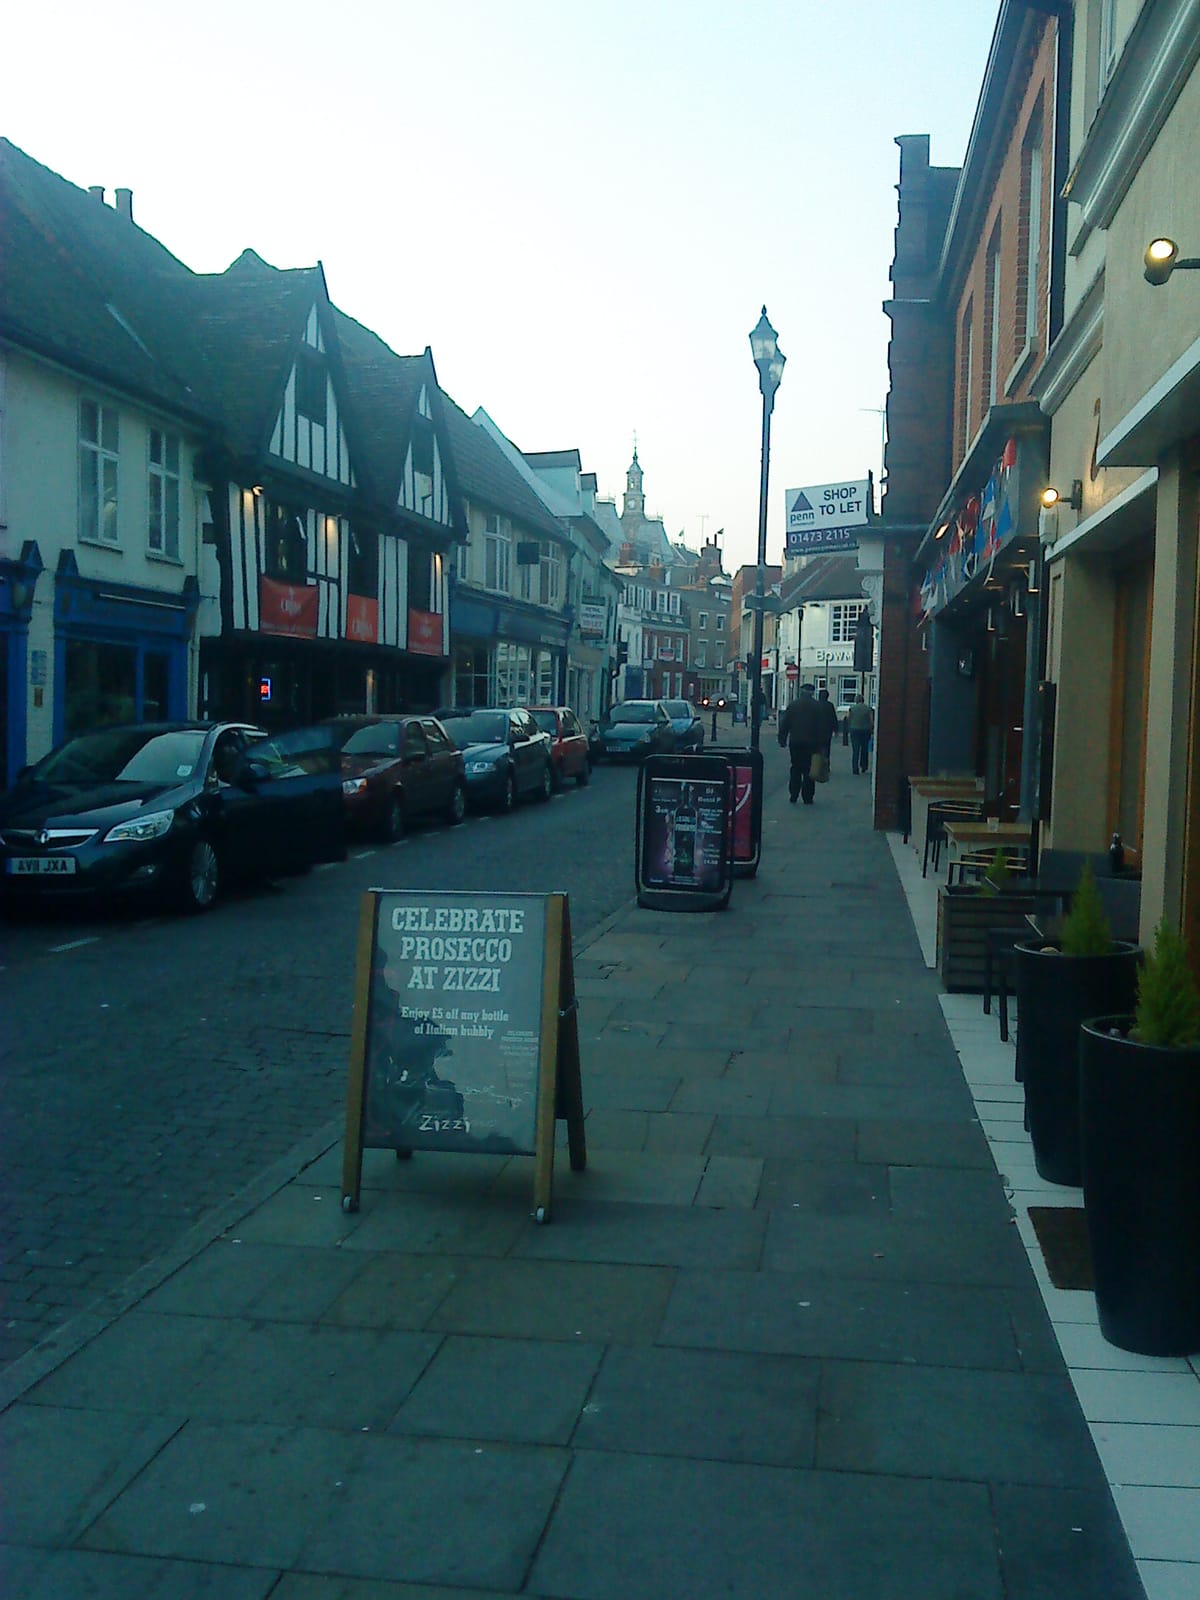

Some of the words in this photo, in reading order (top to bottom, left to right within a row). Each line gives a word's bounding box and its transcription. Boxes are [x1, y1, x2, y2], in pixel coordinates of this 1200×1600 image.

[823, 487, 857, 501] SHOP
[818, 503, 836, 516] TO
[839, 501, 863, 514] LET
[790, 512, 815, 524] penn
[790, 530, 823, 544] 01473
[825, 529, 851, 541] 2115
[43, 859, 68, 873] JXA
[392, 906, 525, 933] CELEBRATE
[400, 936, 513, 963] PROSECCO
[407, 966, 439, 990] AT
[442, 967, 502, 992] ZIZZI
[400, 1006, 430, 1021] Enjoy
[431, 1007, 444, 1020] £5
[445, 1008, 459, 1020] off
[460, 1011, 480, 1023] any
[481, 1009, 510, 1022] bottle
[414, 1023, 425, 1035] of
[426, 1023, 459, 1036] Italian
[460, 1024, 496, 1039] bubbly
[419, 1114, 471, 1133] Zizzi
